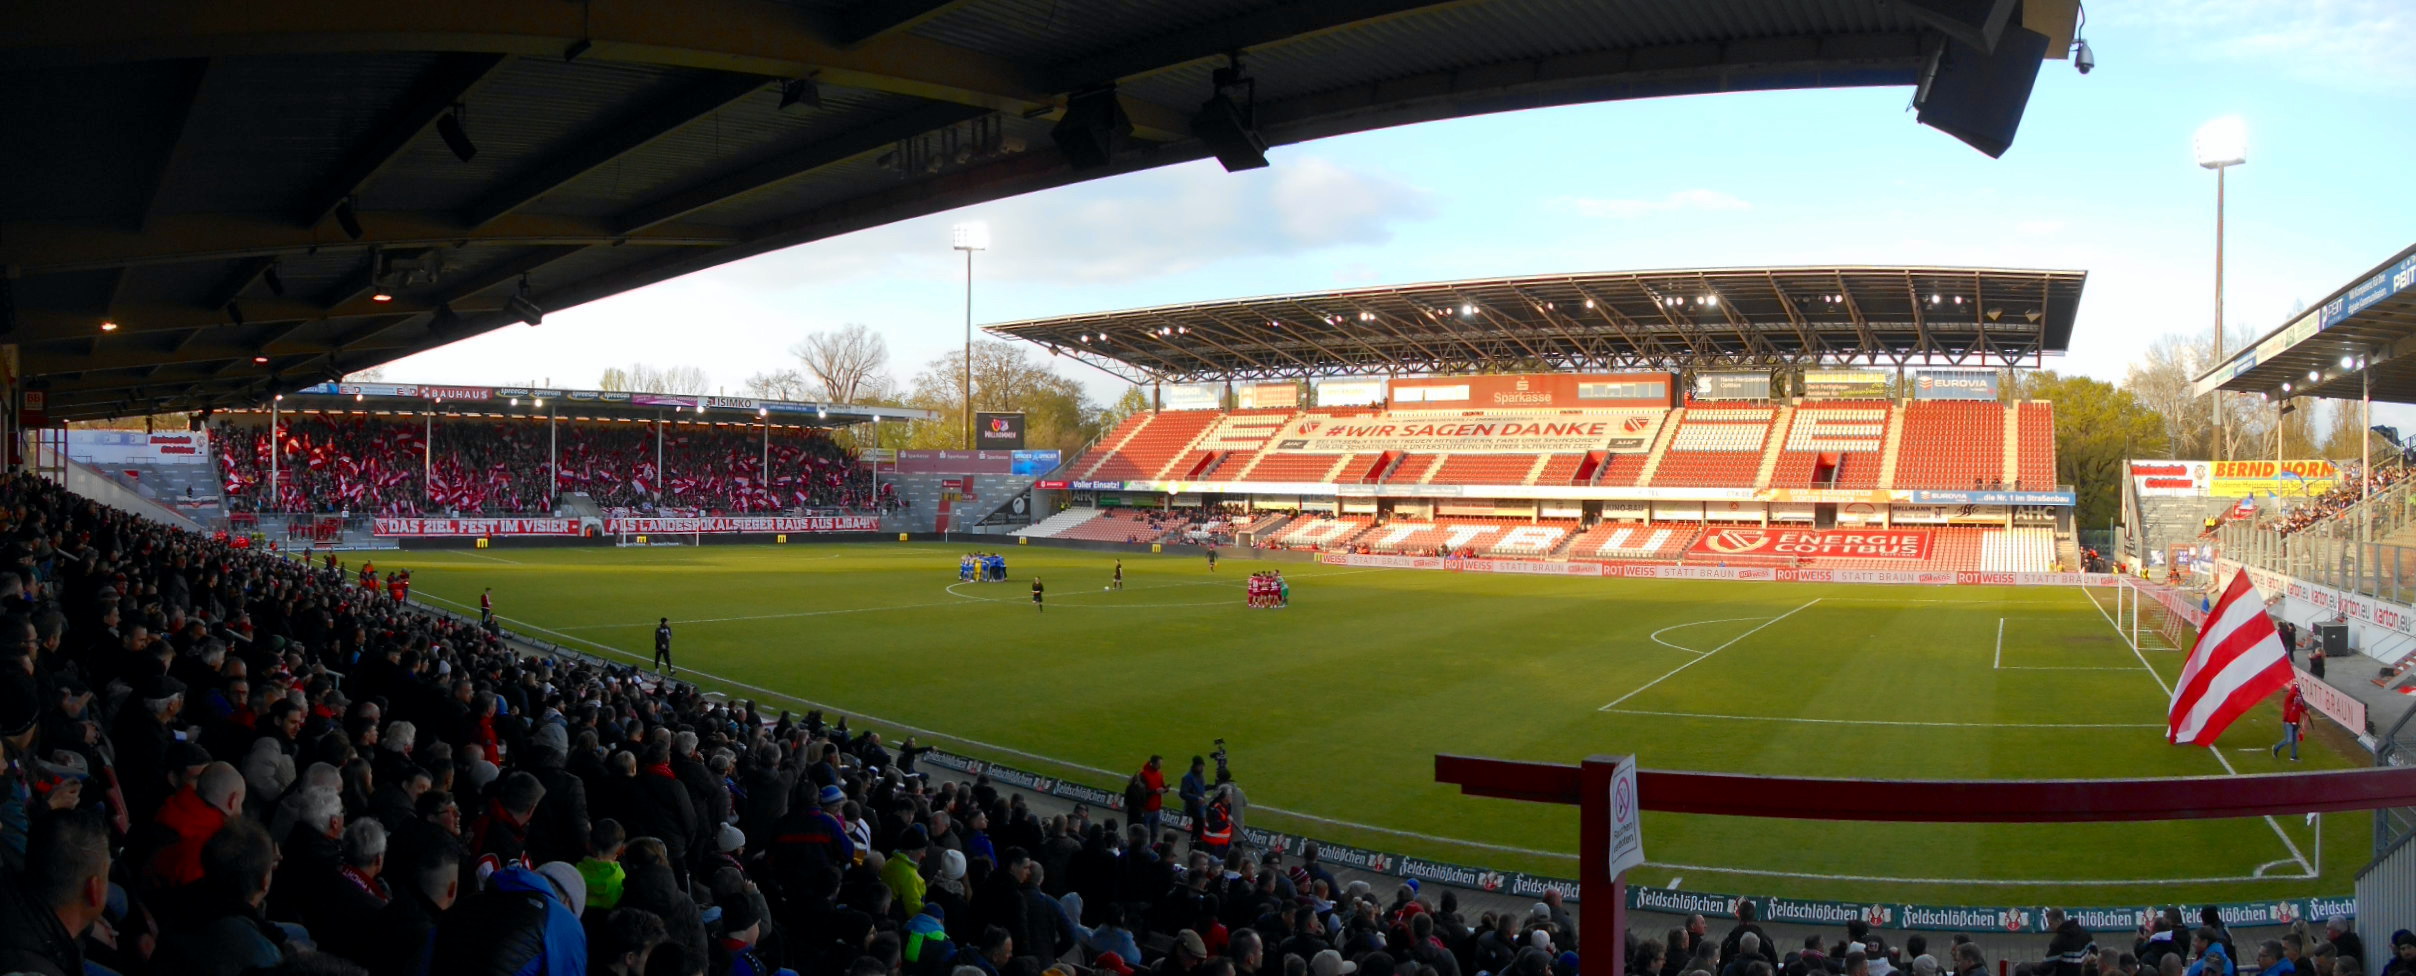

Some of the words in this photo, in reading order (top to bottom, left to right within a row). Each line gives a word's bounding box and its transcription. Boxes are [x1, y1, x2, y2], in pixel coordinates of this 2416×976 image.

[1934, 379, 1988, 388] EUROVIA
[431, 390, 488, 399] BAUHAUS
[1493, 392, 1552, 405] Sparkasse
[717, 397, 752, 409] ISIMKO
[1326, 424, 1396, 437] #WIR
[1400, 423, 1496, 437] SAGEN
[1500, 422, 1608, 436] DANKE
[2215, 462, 2275, 477] BERND
[1073, 480, 1092, 489] Voller
[1093, 480, 1120, 489] Einsatz!
[1996, 494, 2007, 502] Nr.
[2015, 494, 2026, 502] im
[2026, 494, 2070, 503] Straßenbau
[2014, 505, 2055, 520] AHC
[388, 519, 420, 534] DAS
[423, 519, 456, 534] ZIEL
[459, 519, 498, 534] FEST
[500, 519, 519, 533] IM
[523, 519, 569, 533] VISIER
[609, 519, 637, 532] ALS
[639, 518, 775, 532] LANDESPOKALSIEGER
[776, 518, 807, 531] RAUS
[809, 517, 832, 530] AUS
[1777, 535, 1919, 546] ENERGIE
[1774, 543, 1919, 555] COTTBUS
[1323, 554, 1347, 565] WEISS
[1352, 556, 1378, 565] STATT
[1445, 558, 1463, 570] ROT
[1465, 560, 1493, 571] WEISS
[1500, 562, 1528, 571] STATT
[1532, 563, 1565, 573] BRAUN
[1603, 565, 1623, 577] ROT
[1625, 565, 1656, 577] WEISS
[1664, 568, 1697, 578] STATT
[1699, 568, 1735, 579] BRAUN
[1776, 569, 1799, 581] ROT
[1800, 570, 1832, 581] WEISS
[1841, 572, 1873, 582] STATT
[1878, 573, 1915, 583] BRAUN
[1958, 572, 1981, 584] ROT
[1982, 573, 2015, 584] WEISS
[2024, 575, 2054, 585] STATT
[2060, 576, 2099, 586] BRAUN
[2310, 588, 2337, 608] karton.eu
[2338, 591, 2370, 620] karton.eu
[2373, 602, 2411, 633] karton.eu
[2301, 676, 2322, 699] STATT
[2325, 691, 2354, 726] BRAUN
[1053, 778, 1106, 804] Feldschlößchen
[1400, 855, 1476, 886] Feldschlößchen
[1636, 886, 1724, 914] Feldschlößchen
[1767, 896, 1858, 922] Feldschlößchen
[1902, 903, 1995, 930] Feldschlößchen
